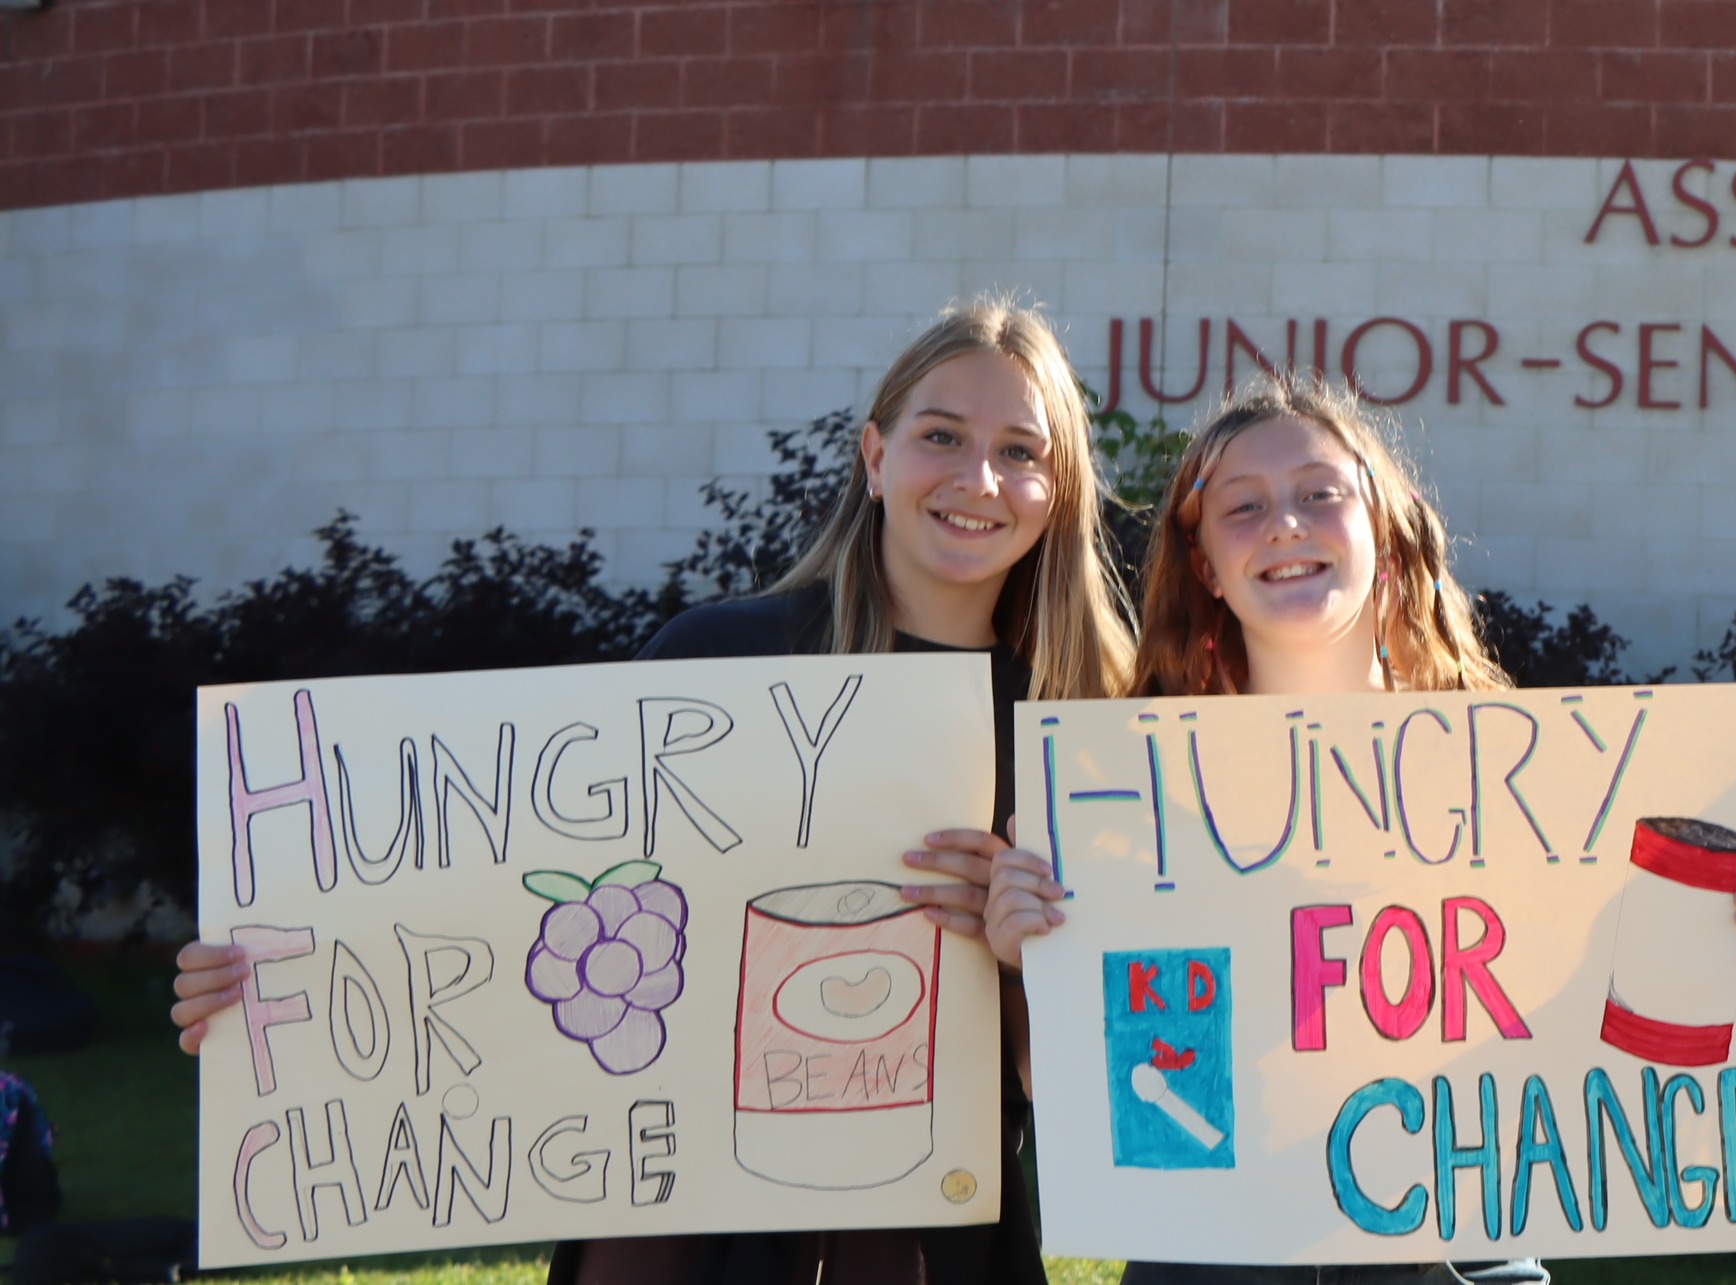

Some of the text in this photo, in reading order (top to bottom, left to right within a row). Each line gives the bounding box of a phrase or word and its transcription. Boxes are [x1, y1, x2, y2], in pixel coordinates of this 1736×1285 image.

[224, 674, 864, 908] HUNGRY
[1040, 690, 1653, 900] HUNGRY
[230, 923, 495, 1097] FOR
[1290, 896, 1533, 1052] FOR
[763, 1042, 930, 1111] BEANS
[233, 1098, 677, 1250] CHANGE
